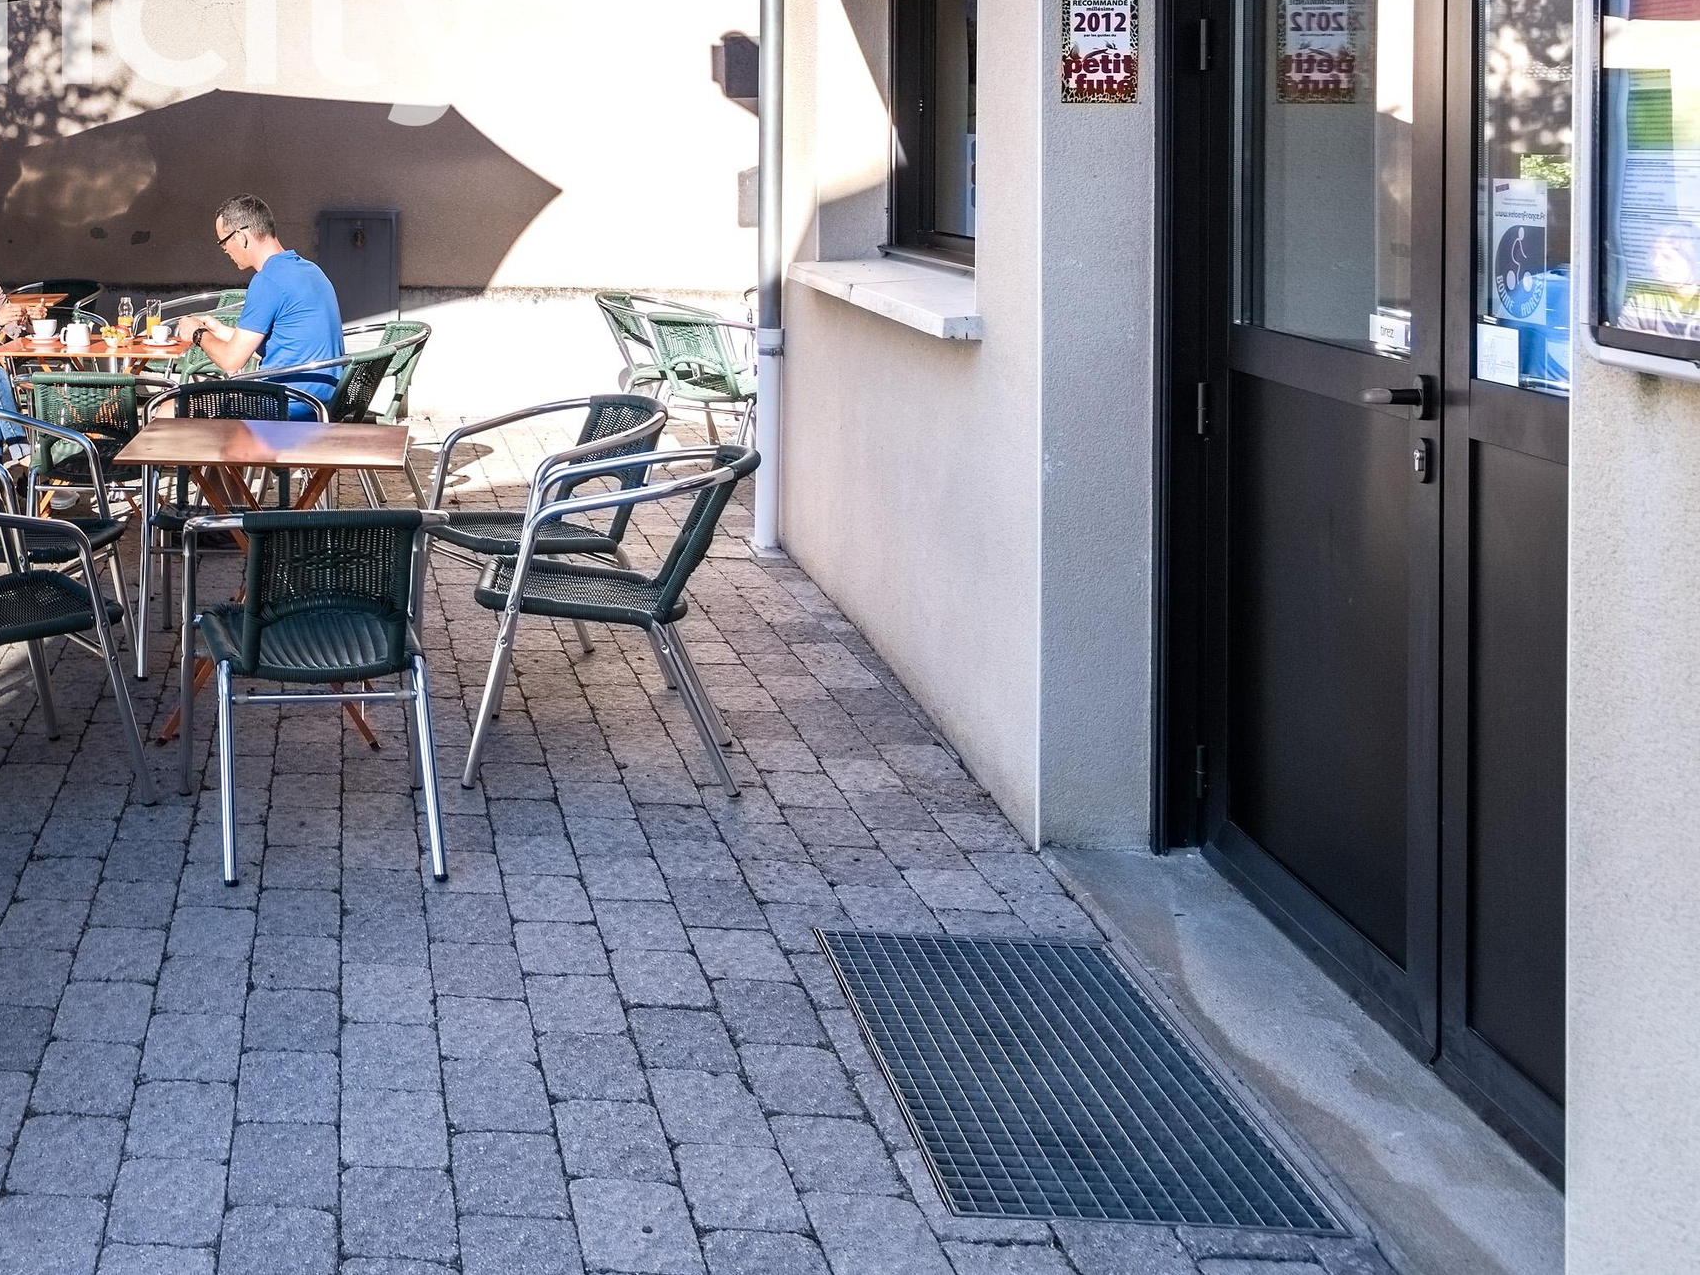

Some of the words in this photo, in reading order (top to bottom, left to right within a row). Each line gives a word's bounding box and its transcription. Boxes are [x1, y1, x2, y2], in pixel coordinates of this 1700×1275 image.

[1072, 0, 1129, 7] RECOMMANDÉ
[1073, 12, 1127, 33] 2012
[1063, 52, 1134, 79] petit
[1380, 325, 1395, 339] tirez
